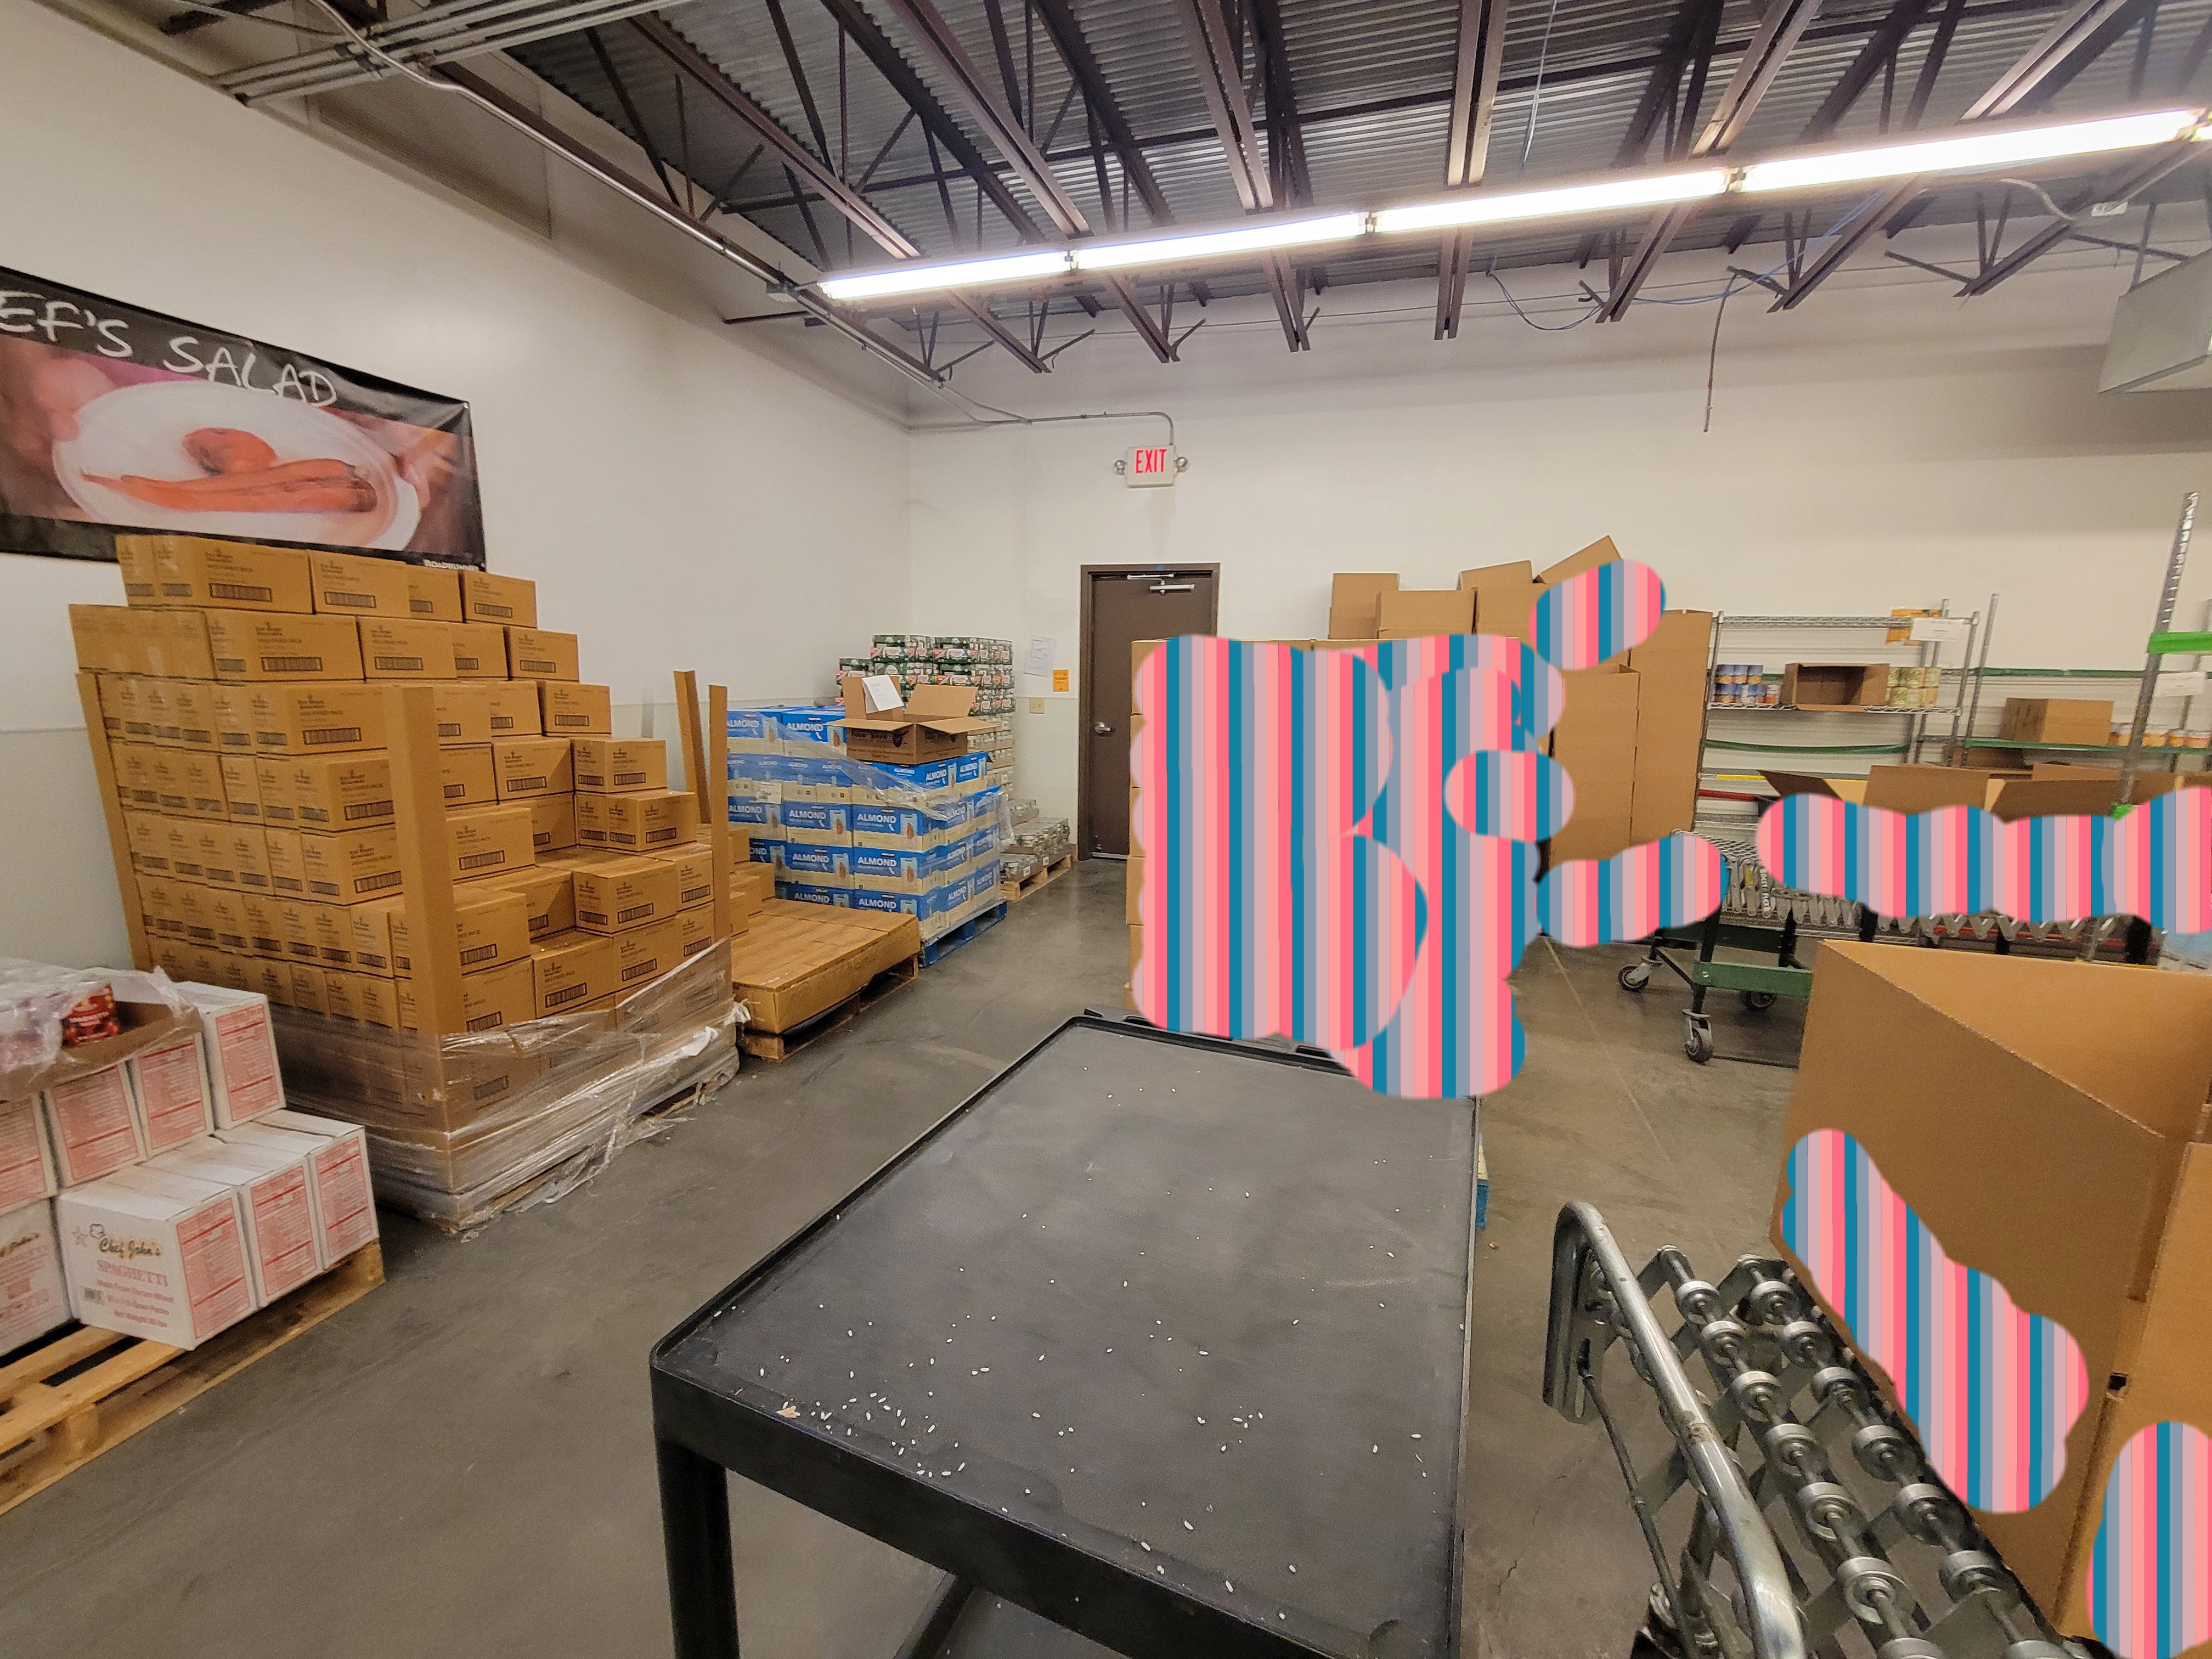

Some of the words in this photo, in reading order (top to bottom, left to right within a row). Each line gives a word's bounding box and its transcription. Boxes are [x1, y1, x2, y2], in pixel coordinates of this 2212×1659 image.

[163, 336, 337, 407] SALAD
[1135, 449, 1167, 473] EXIT
[727, 720, 760, 729] ALMOND
[786, 723, 824, 732] ALMOND
[926, 769, 947, 782] ALMOND
[729, 805, 762, 814] ALMOND
[789, 810, 827, 820] ALMOND
[857, 813, 897, 824] ALMOND
[792, 853, 830, 864] ALMOND
[857, 856, 897, 867] ALMOND
[795, 893, 830, 904] ALMOND
[948, 885, 967, 901] ALMOND
[858, 898, 897, 909] ALMOND
[99, 1238, 125, 1259] Chef
[97, 1260, 168, 1287] SPAGHETTI
